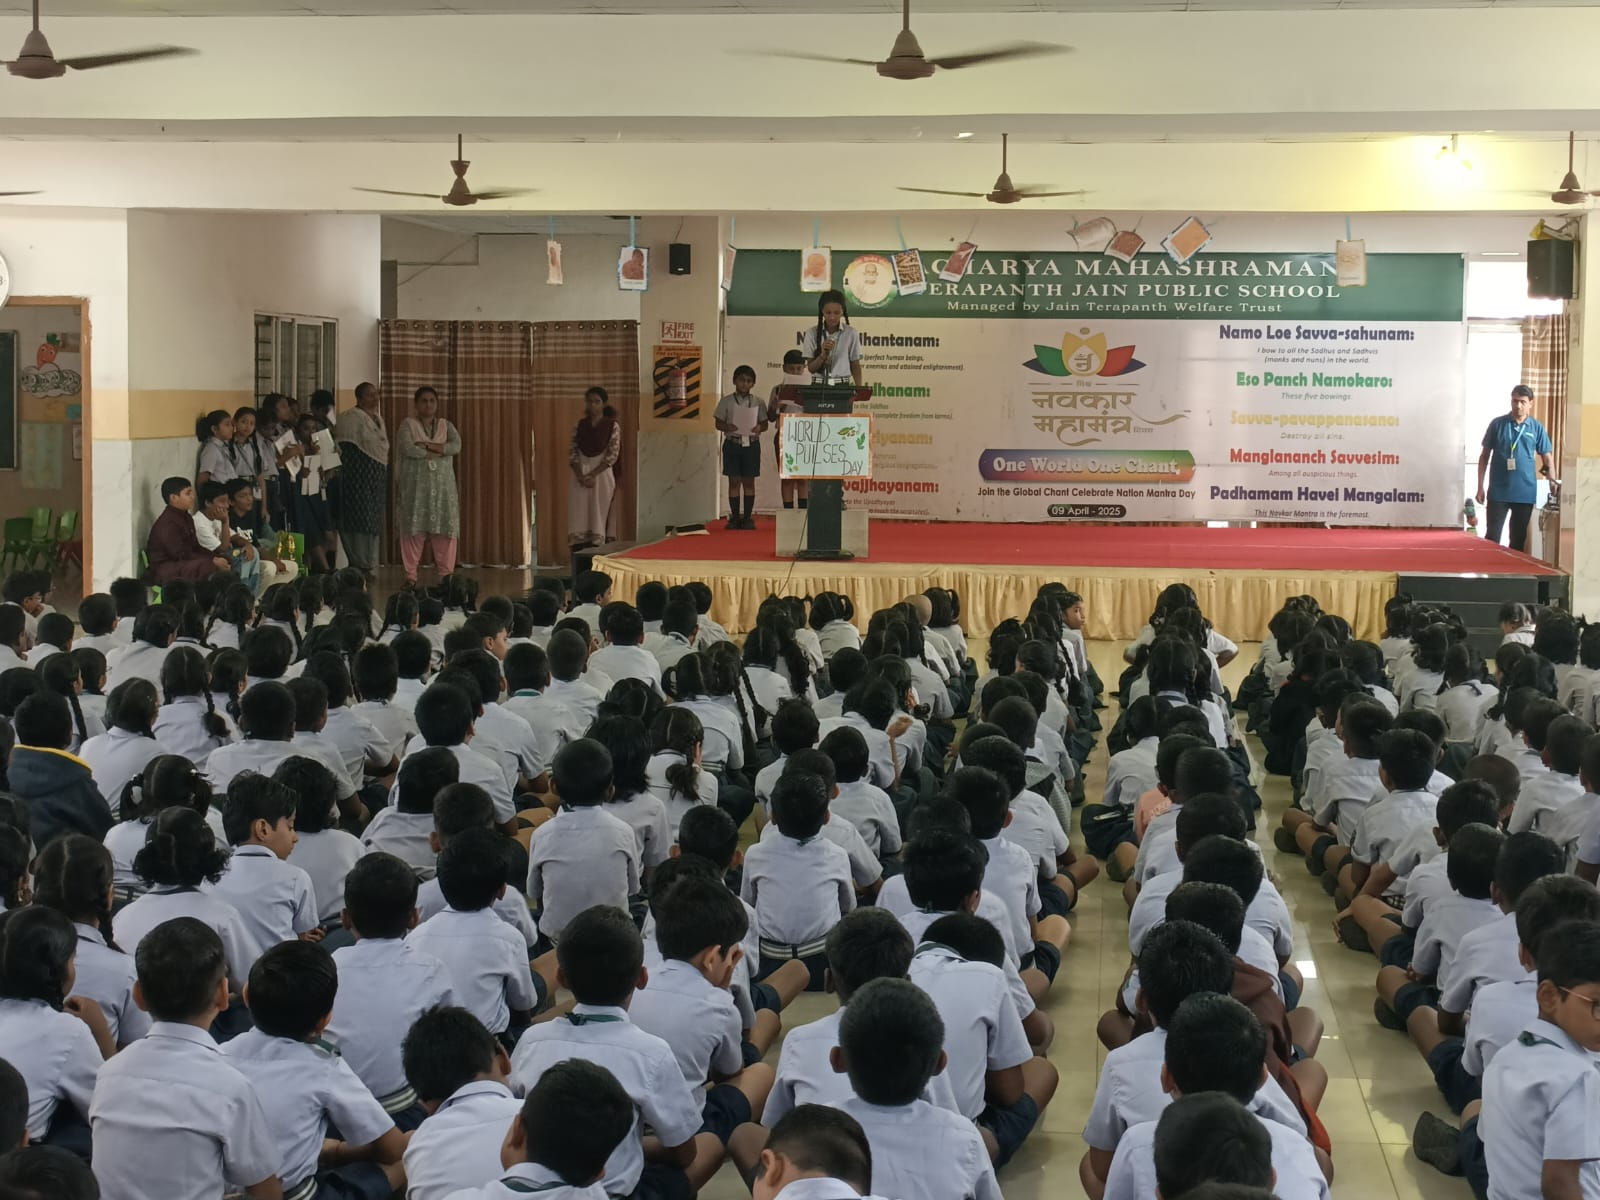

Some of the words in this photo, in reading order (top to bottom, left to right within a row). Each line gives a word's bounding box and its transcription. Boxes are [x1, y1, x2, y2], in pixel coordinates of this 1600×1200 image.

[924, 258, 1062, 276] CARYA
[1074, 259, 1338, 277] MAHASHRAMAN
[929, 283, 1063, 296] ERAPANTH
[1072, 283, 1129, 297] JAIN
[1138, 284, 1229, 297] PUBLIC
[1238, 284, 1340, 298] SCHOOL
[947, 301, 1015, 313] Managed
[1023, 302, 1040, 312] by
[1046, 302, 1080, 311] Jain
[1086, 302, 1168, 313] Terapanth
[1174, 302, 1233, 312] Welfare
[1240, 303, 1283, 312] Trust
[678, 322, 694, 331] FIRE
[678, 331, 694, 339] EXIT
[1219, 324, 1262, 340] Namo
[1266, 325, 1292, 340] Loe
[1295, 325, 1415, 342] Savva-sahunam:
[1236, 371, 1260, 386] Eso
[1264, 371, 1308, 387] Panch
[1312, 372, 1393, 388] Namokaro:
[1031, 391, 1137, 410] नवकार
[788, 420, 831, 443] WORLD
[796, 442, 847, 465] PULSES
[1330, 449, 1400, 465] Savvesim:
[841, 459, 863, 476] DAY
[992, 457, 1026, 473] One
[1030, 457, 1083, 473] World
[1088, 457, 1121, 474] One
[843, 478, 939, 495] vajjhayanam:
[977, 487, 995, 496] Join
[997, 487, 1010, 496] the
[1013, 487, 1041, 496] Global
[1044, 488, 1069, 497] Chant
[1071, 488, 1114, 497] Celebrate
[1116, 488, 1144, 497] Nation
[1146, 488, 1177, 498] Mantra
[1179, 489, 1196, 499] Day
[1210, 486, 1293, 501] Padhamam
[1344, 488, 1425, 504] Mangalam:
[1051, 506, 1065, 516] 09
[1067, 506, 1090, 518] April
[1098, 507, 1121, 516] 2025
